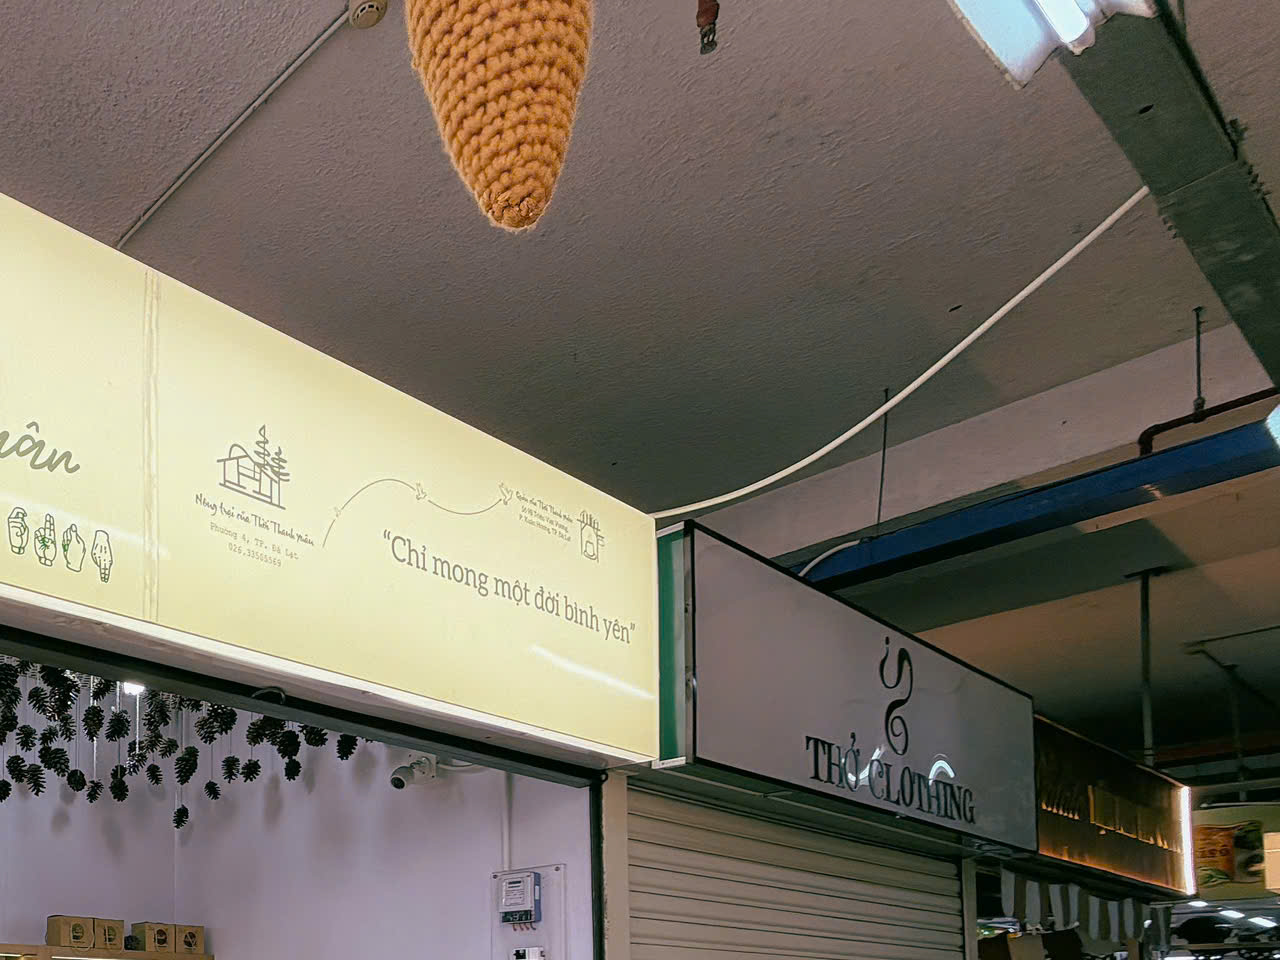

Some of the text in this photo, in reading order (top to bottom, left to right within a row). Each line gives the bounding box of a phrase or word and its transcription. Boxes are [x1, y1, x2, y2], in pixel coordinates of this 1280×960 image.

[432, 555, 489, 597] mong
[493, 580, 531, 607] một
[534, 586, 560, 617] đời
[564, 595, 600, 633] bình
[805, 732, 861, 793] THỞ
[867, 758, 977, 824] CLOTHING
